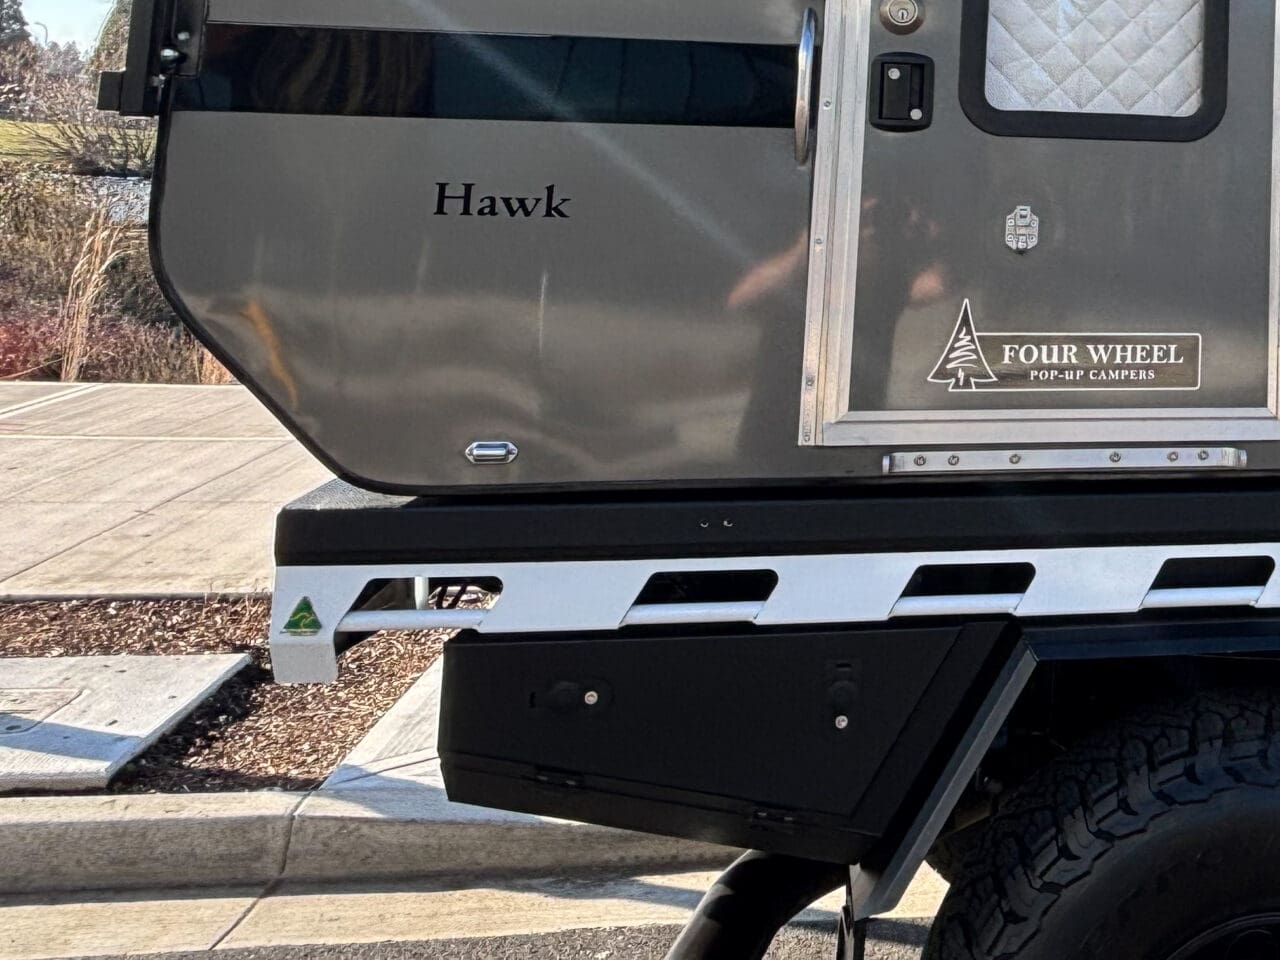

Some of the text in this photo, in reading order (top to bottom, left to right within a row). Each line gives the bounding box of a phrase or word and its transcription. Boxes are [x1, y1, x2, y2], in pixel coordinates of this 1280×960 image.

[433, 182, 572, 218] Hawk
[1002, 344, 1184, 365] FOUR WHEEL
[1030, 369, 1155, 381] POP-UP CAMPERS
